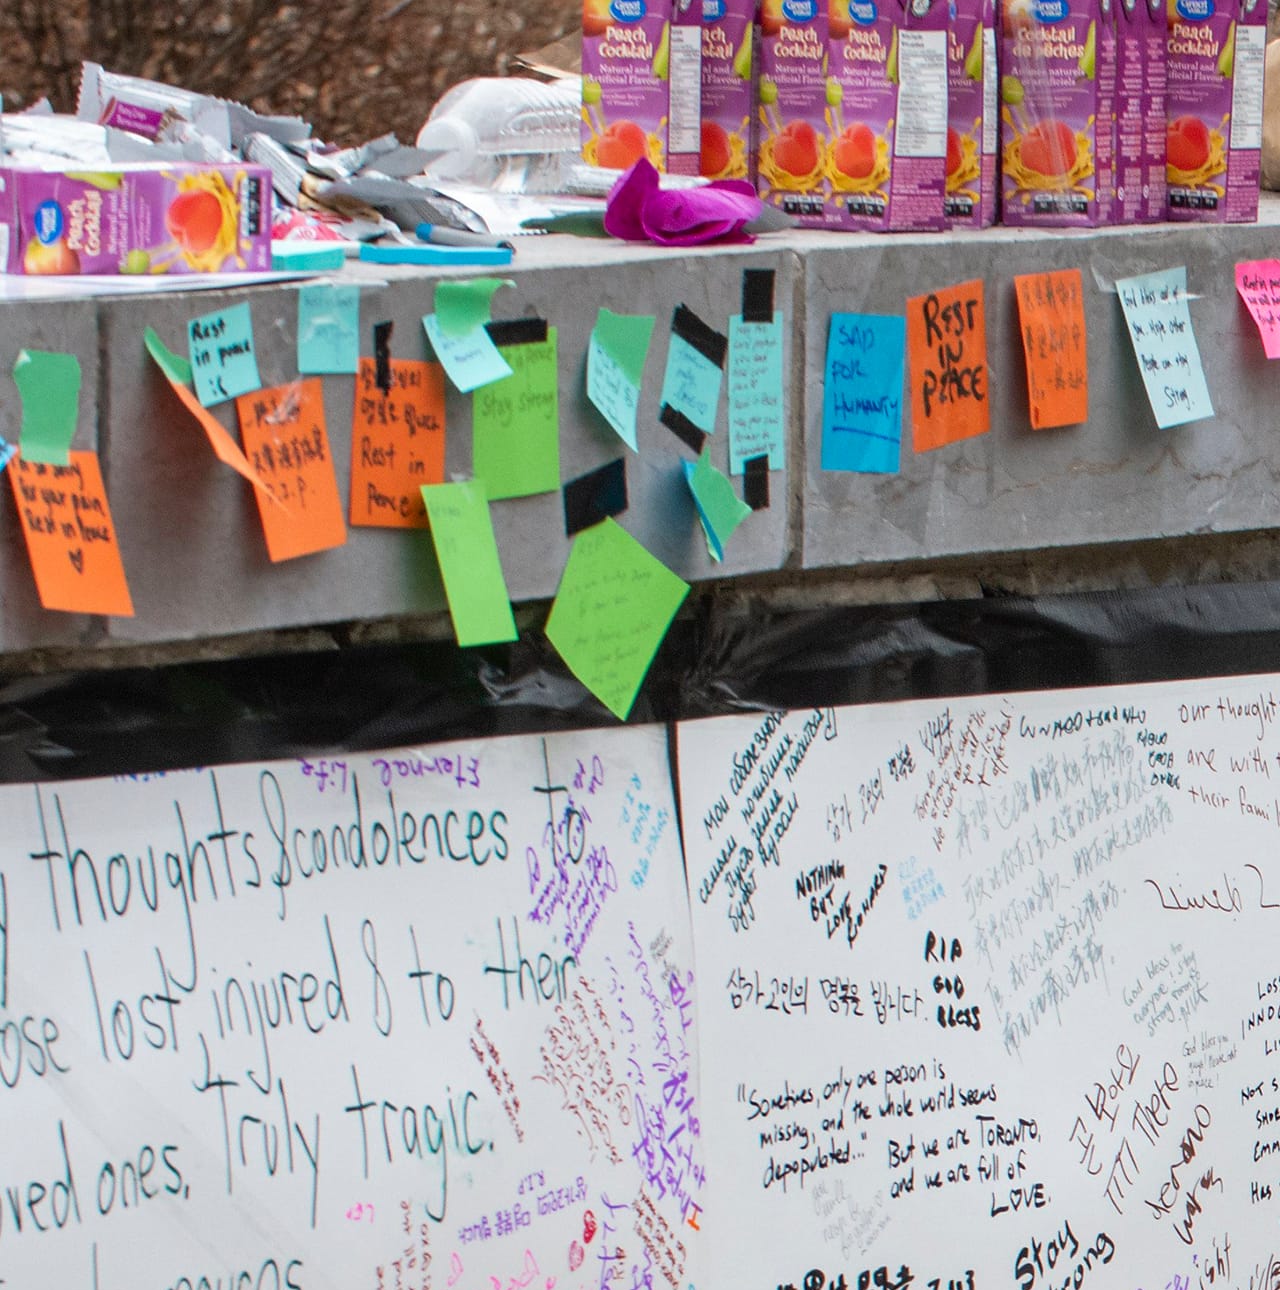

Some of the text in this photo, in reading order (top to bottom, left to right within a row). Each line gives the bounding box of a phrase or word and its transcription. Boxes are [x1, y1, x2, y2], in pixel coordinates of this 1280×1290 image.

[606, 26, 646, 43] Peach
[849, 28, 881, 45] Peach
[1172, 23, 1213, 42] Peach
[599, 42, 653, 60] Cocktail
[843, 44, 886, 62] Cocktail
[1167, 40, 1218, 58] Cocktail
[938, 340, 963, 368] IN
[1187, 748, 1217, 773] are
[1230, 747, 1270, 779] with
[1188, 785, 1230, 808] their
[29, 768, 262, 993] thoughts
[293, 771, 509, 880] condolences
[533, 737, 586, 866] to
[924, 930, 963, 964] RIP
[0, 1015, 72, 1088] ose
[211, 914, 350, 1096] injured
[361, 917, 393, 1037] &
[409, 925, 454, 1028] to
[485, 916, 579, 1013] their
[823, 1066, 851, 1107] only
[857, 1069, 878, 1090] one
[885, 1064, 927, 1098] person
[932, 1058, 946, 1081] is
[1241, 1081, 1264, 1105] NOT
[821, 1109, 845, 1132] and
[852, 1100, 872, 1124] the
[879, 1090, 914, 1118] whole
[920, 1083, 956, 1114] world
[3, 1119, 82, 1233] ved
[194, 1076, 320, 1229] Truly
[887, 1133, 916, 1169] But
[922, 1139, 940, 1159] we
[946, 1127, 971, 1151] are
[890, 1149, 1028, 1199] and we are full of
